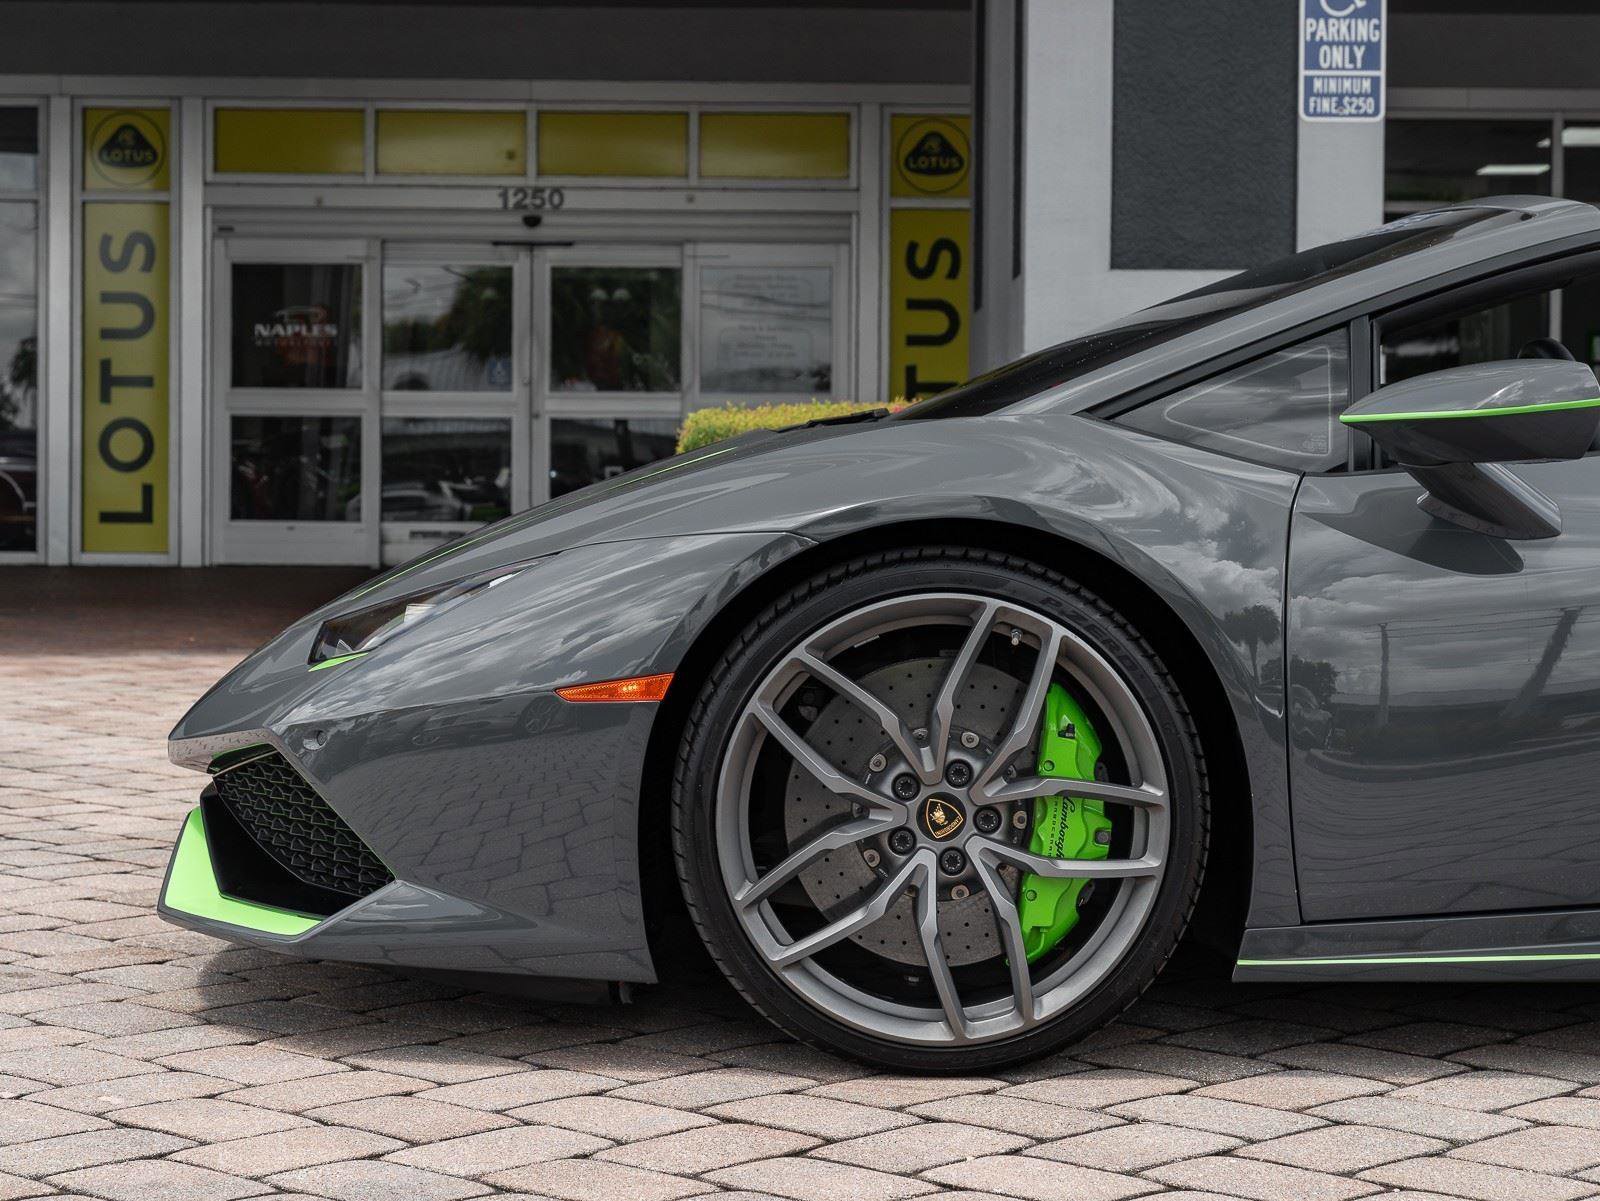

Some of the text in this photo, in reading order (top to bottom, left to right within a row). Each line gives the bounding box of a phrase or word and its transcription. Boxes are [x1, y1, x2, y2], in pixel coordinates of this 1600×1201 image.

[1305, 17, 1380, 42] PARKING
[1318, 44, 1366, 69] ONLY
[1313, 77, 1371, 95] MINIMUM
[1308, 95, 1375, 116] FINE $250
[101, 148, 154, 163] LOTUS
[908, 155, 961, 170] LOTUS
[498, 186, 565, 210] 1250
[254, 323, 338, 338] NAPLES
[905, 237, 962, 402] TUS
[98, 230, 156, 525] LOTUS
[1055, 796, 1076, 858] Lamborgh
